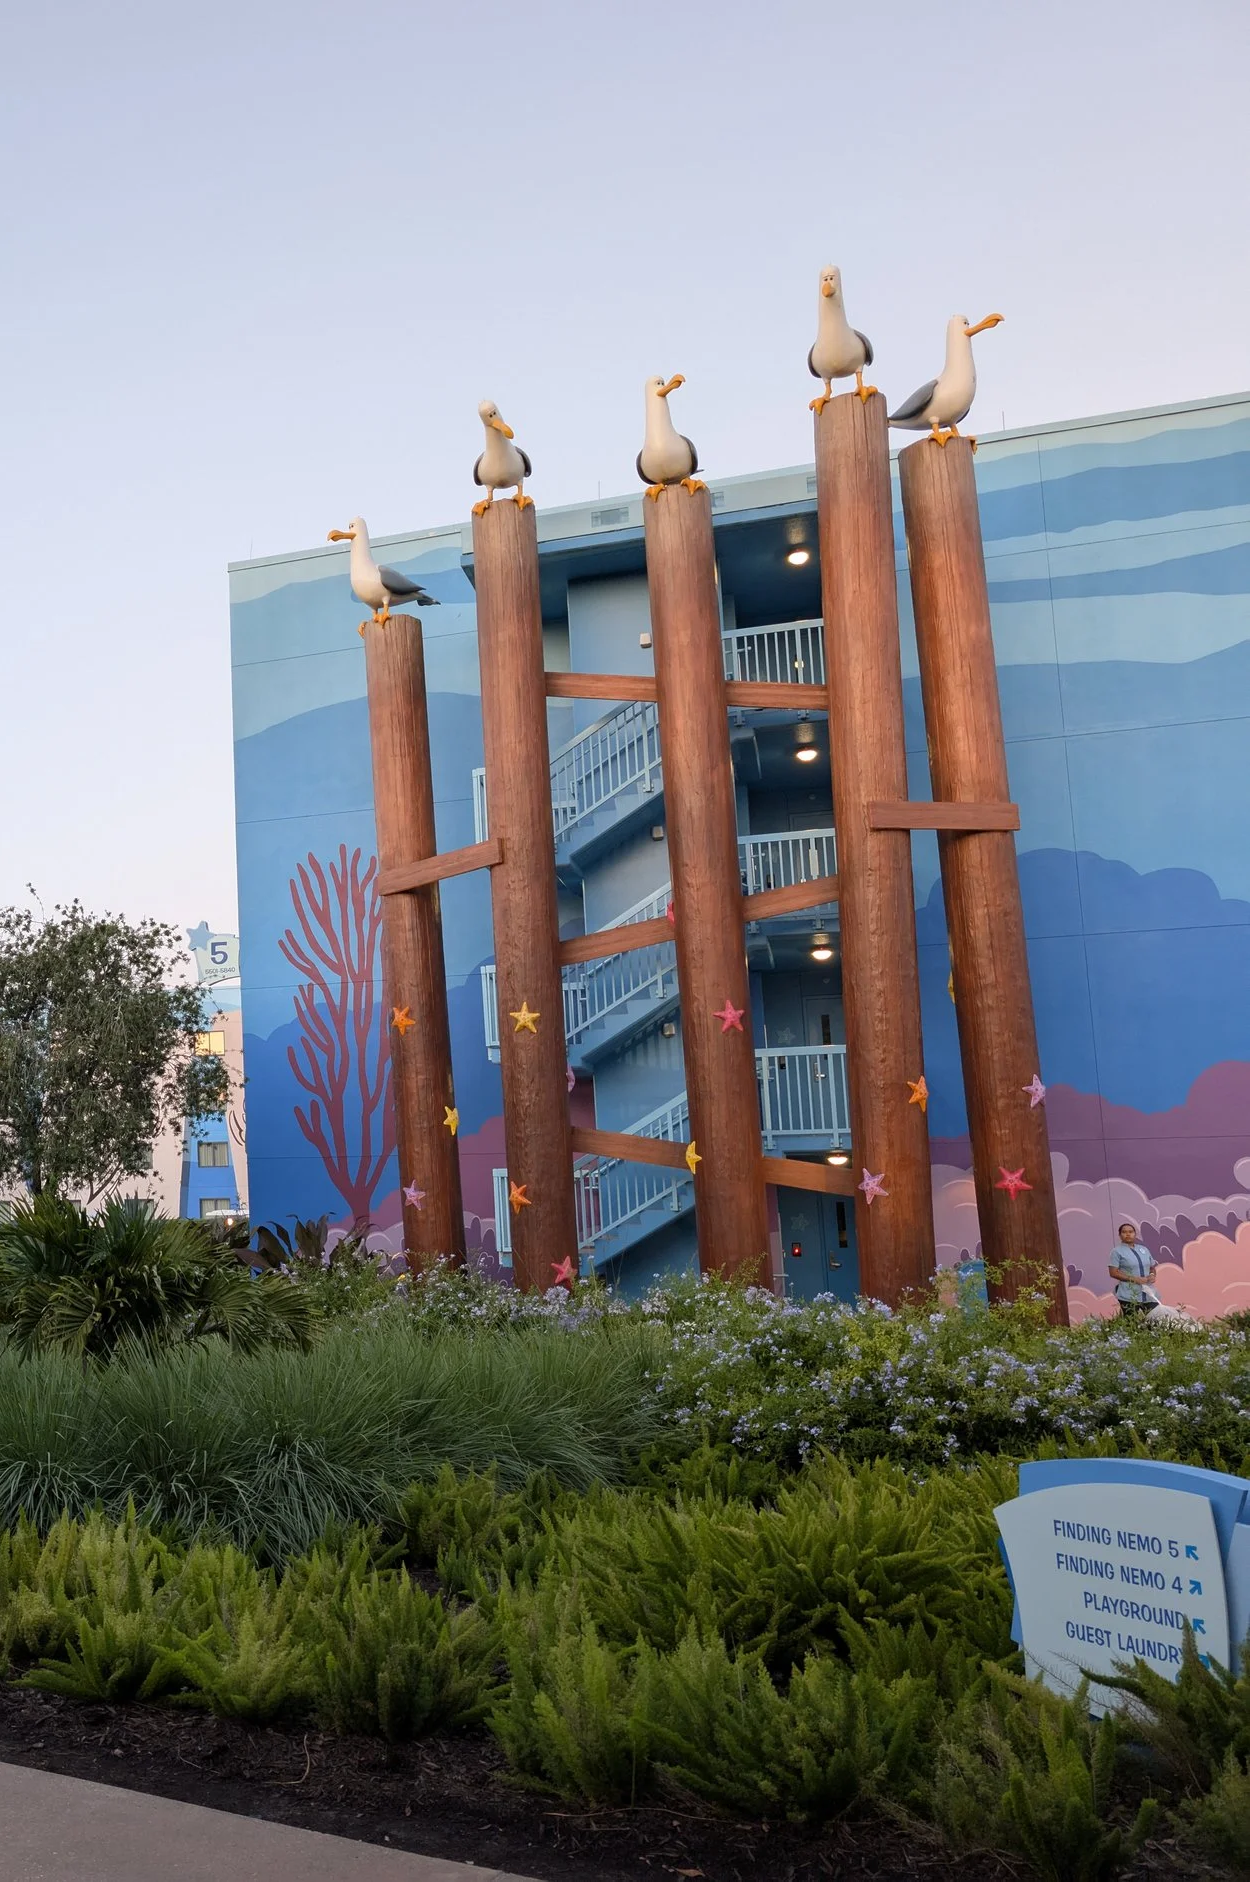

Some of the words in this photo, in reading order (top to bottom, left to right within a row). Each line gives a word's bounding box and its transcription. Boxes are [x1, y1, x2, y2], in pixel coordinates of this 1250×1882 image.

[211, 941, 228, 965] 5
[1053, 1519, 1112, 1546] FINDING
[1117, 1530, 1162, 1555] NEMO
[1168, 1540, 1179, 1558] 5
[1056, 1552, 1114, 1580] FINDING
[1120, 1565, 1165, 1591] NEMO
[1171, 1576, 1183, 1594] 4
[1083, 1591, 1186, 1631] PLAYGROUND
[1065, 1621, 1112, 1648] GUEST
